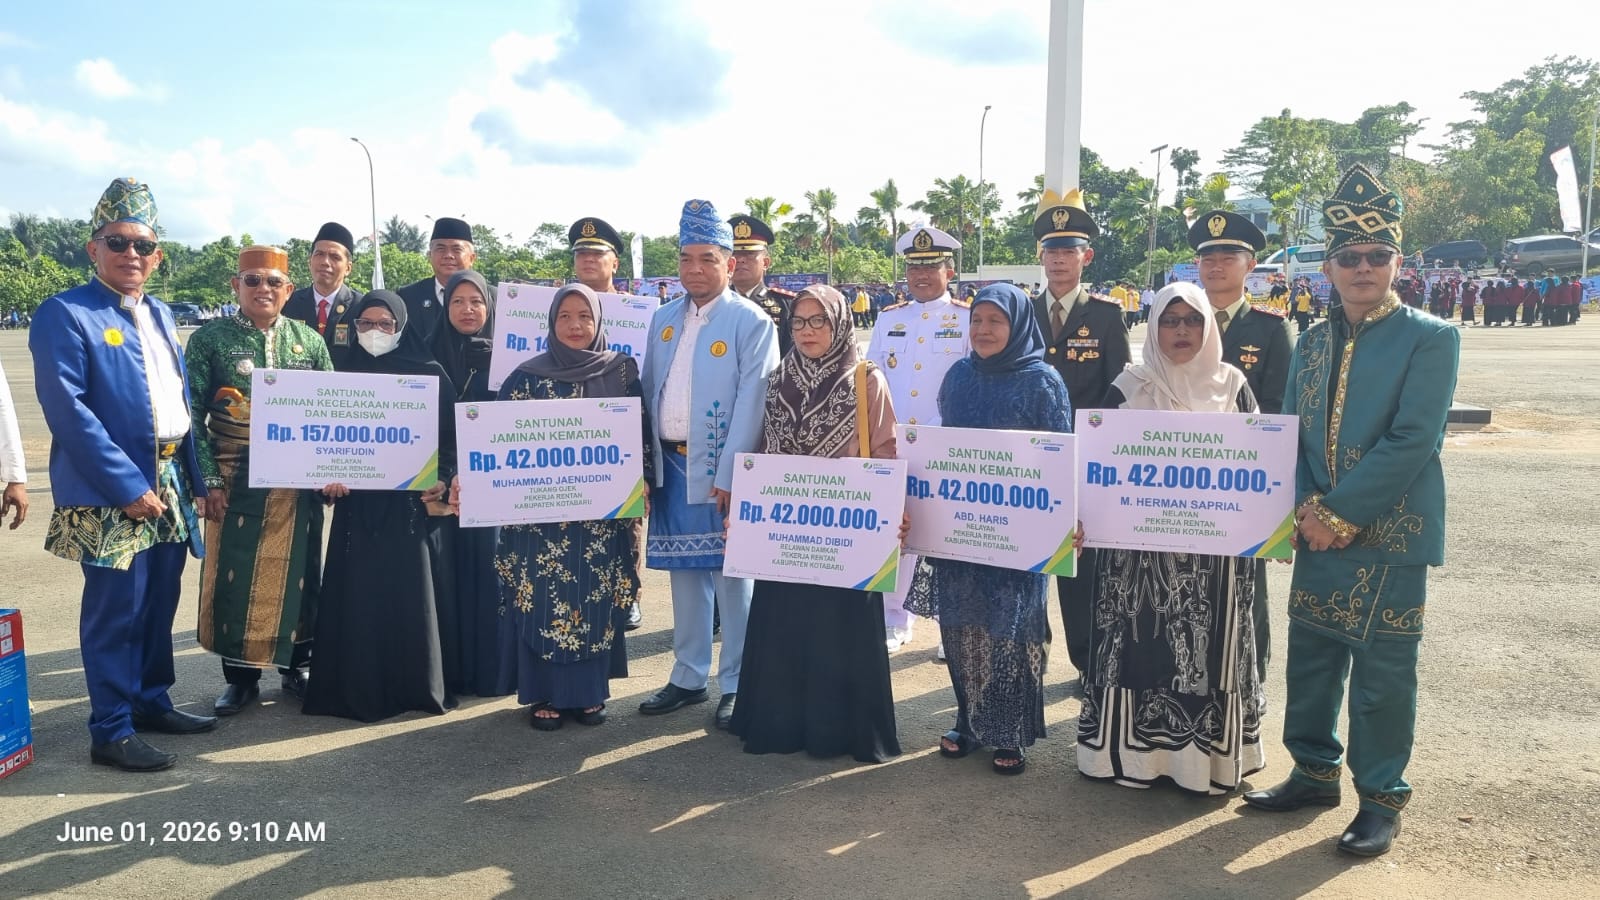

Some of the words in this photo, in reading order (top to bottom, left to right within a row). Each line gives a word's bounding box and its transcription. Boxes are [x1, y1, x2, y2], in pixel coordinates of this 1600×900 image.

[506, 309, 548, 319] JAMINAN
[616, 320, 646, 329] KERJA
[507, 334, 530, 351] Rp.
[317, 388, 375, 397] SANTUNAN
[265, 398, 313, 406] JAMINAN
[317, 400, 390, 409] KECELAKAAN
[393, 401, 427, 410] KERJA
[331, 410, 386, 419] BEASISWA
[515, 417, 582, 429] SANTUNAN
[267, 424, 295, 442] Rp.
[300, 424, 420, 445] 157.000.000,-
[490, 432, 545, 443] JAMINAN
[550, 430, 611, 440] KEMATIAN
[1143, 431, 1223, 444] SANTUNAN
[315, 447, 375, 455] SYARIFUDIN
[948, 448, 1012, 462] SANTUNAN
[1112, 445, 1177, 457] JAMINAN
[1182, 448, 1258, 460] KEMATIAN
[469, 452, 501, 472] Rp.
[506, 445, 631, 468] 42.000.000,-
[925, 460, 976, 473] JAMINAN
[980, 465, 1041, 479] KEMATIAN
[493, 476, 552, 488] MUHAMMAD
[555, 474, 611, 484] JAENUDDIN
[784, 474, 845, 485] SANTUNAN
[1087, 462, 1122, 487] Rp.
[1128, 464, 1281, 495] 42.000.000,-
[760, 486, 809, 497] JAMINAN
[813, 489, 871, 500] KEMATIAN
[906, 475, 934, 499] Rp.
[938, 479, 1061, 513] 42.000.000,-
[1121, 497, 1132, 506] M.
[1137, 498, 1187, 509] HERMAN
[1190, 501, 1242, 512] SAPRIAL
[739, 501, 766, 523] Rp.
[770, 503, 888, 532] 42.000.000,-
[954, 512, 976, 522] ABD.
[980, 515, 1008, 525] HARIS
[1145, 518, 1181, 526] PEKERJA
[1184, 519, 1216, 528] RENTAN
[966, 524, 995, 532] NELAYAN
[1133, 526, 1180, 534] KABUPATEN
[1182, 528, 1227, 537] KOTABARU
[769, 533, 822, 544] MUHAMMAD
[825, 538, 852, 547] DIBIDI
[953, 530, 982, 538] PEKERJA
[983, 533, 1009, 542] RENTAN
[811, 546, 838, 554] DAMKAR
[944, 537, 981, 547] KABUPATEN
[983, 542, 1018, 552] KOTABARU
[781, 552, 809, 560] PEKERJA
[772, 560, 809, 568] KABUPATEN
[810, 562, 844, 571] KOTABARU
